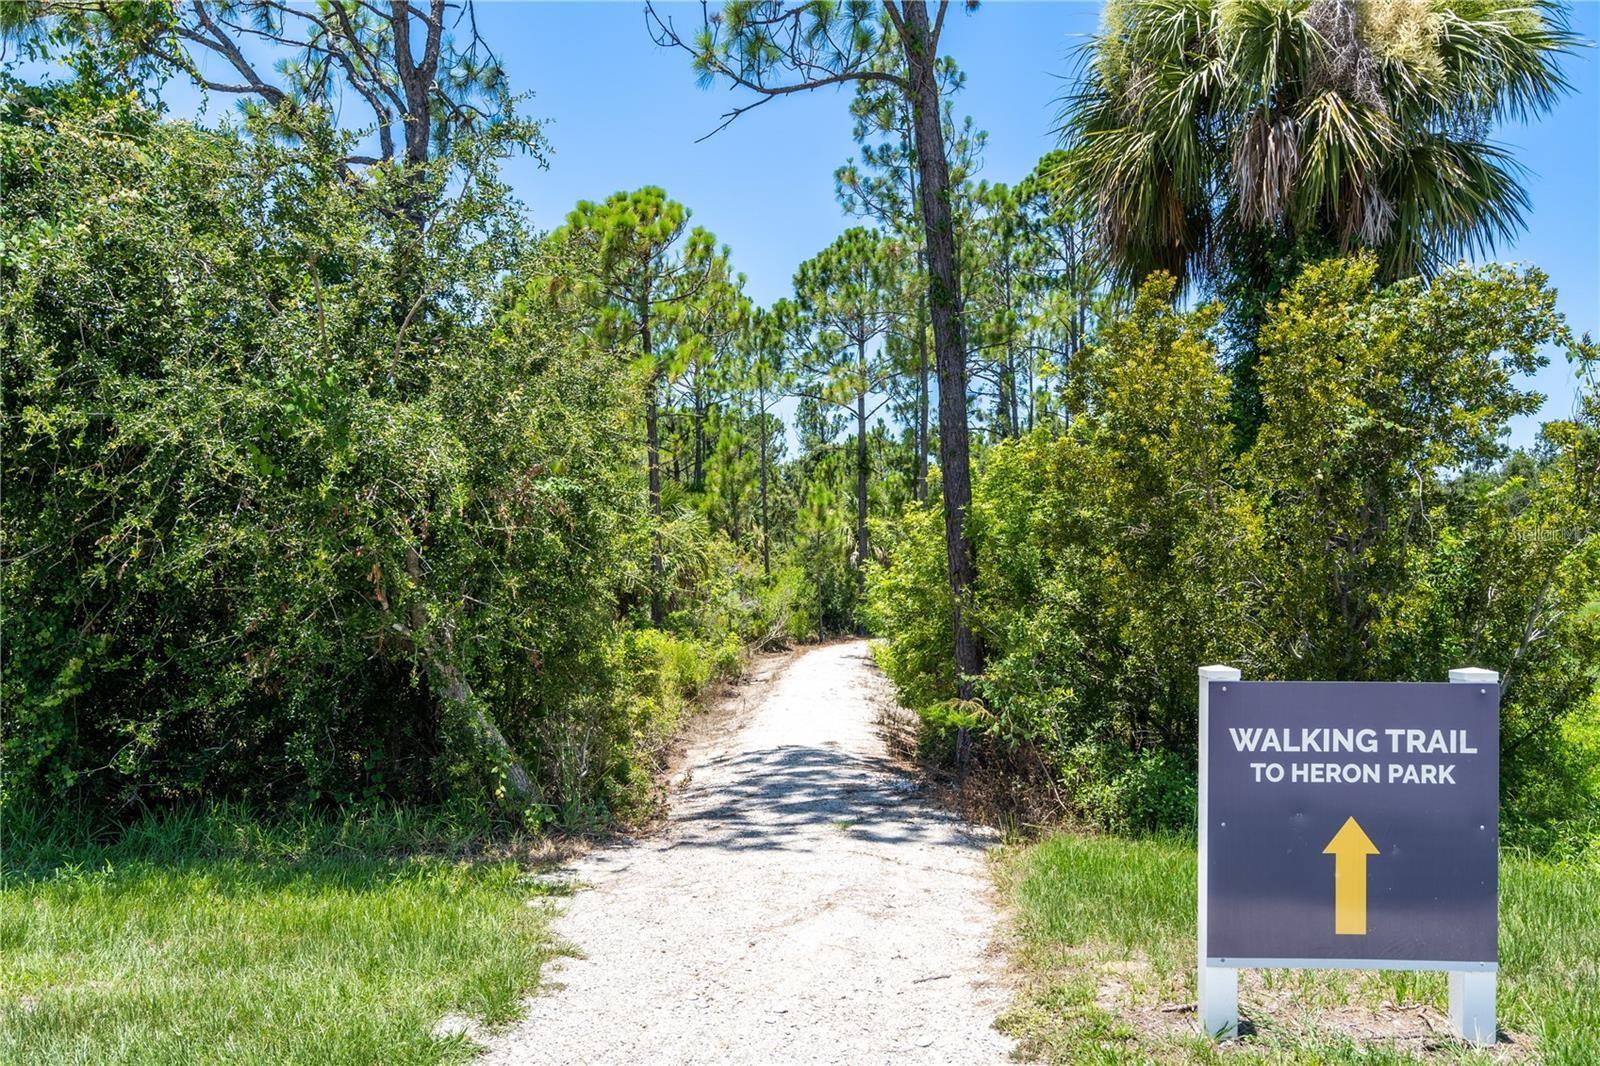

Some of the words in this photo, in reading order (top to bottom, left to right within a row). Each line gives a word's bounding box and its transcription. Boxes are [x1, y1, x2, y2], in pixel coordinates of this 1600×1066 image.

[1229, 727, 1378, 754] WALKING
[1384, 728, 1478, 754] TRAIL
[1250, 762, 1285, 783] TO
[1291, 762, 1381, 784] HERON
[1388, 763, 1456, 785] PARK
